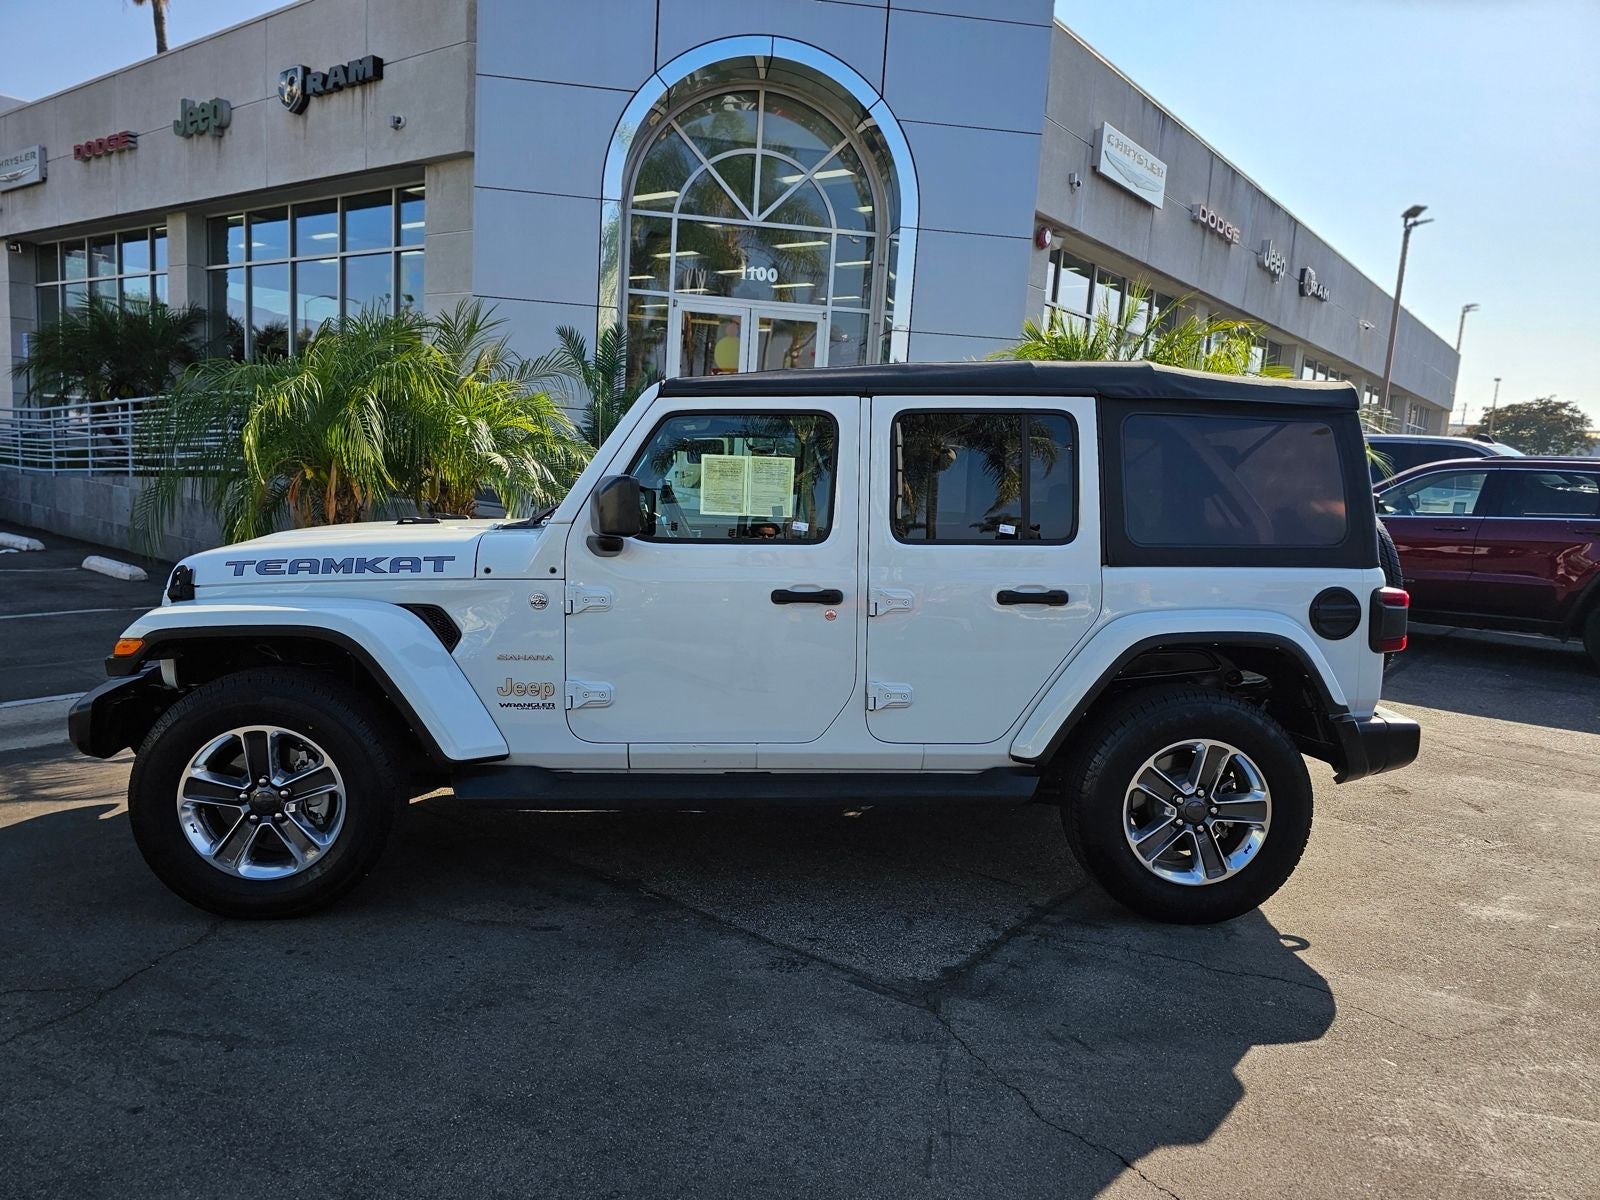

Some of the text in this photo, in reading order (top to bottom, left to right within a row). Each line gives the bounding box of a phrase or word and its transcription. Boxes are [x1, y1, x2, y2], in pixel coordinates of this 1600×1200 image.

[306, 55, 381, 96] RAM
[173, 97, 231, 138] Jeep
[0, 151, 37, 168] HRYSLER
[73, 131, 136, 161] DODGE
[1106, 133, 1164, 178] CHRYSLER
[1199, 204, 1241, 244] DODGE
[740, 265, 779, 283] 1100
[1263, 239, 1286, 284] Jeep
[1311, 280, 1330, 301] RAM
[225, 555, 456, 577] TEAMKAT
[496, 653, 555, 661] SAHARA
[496, 677, 556, 701] Jeep
